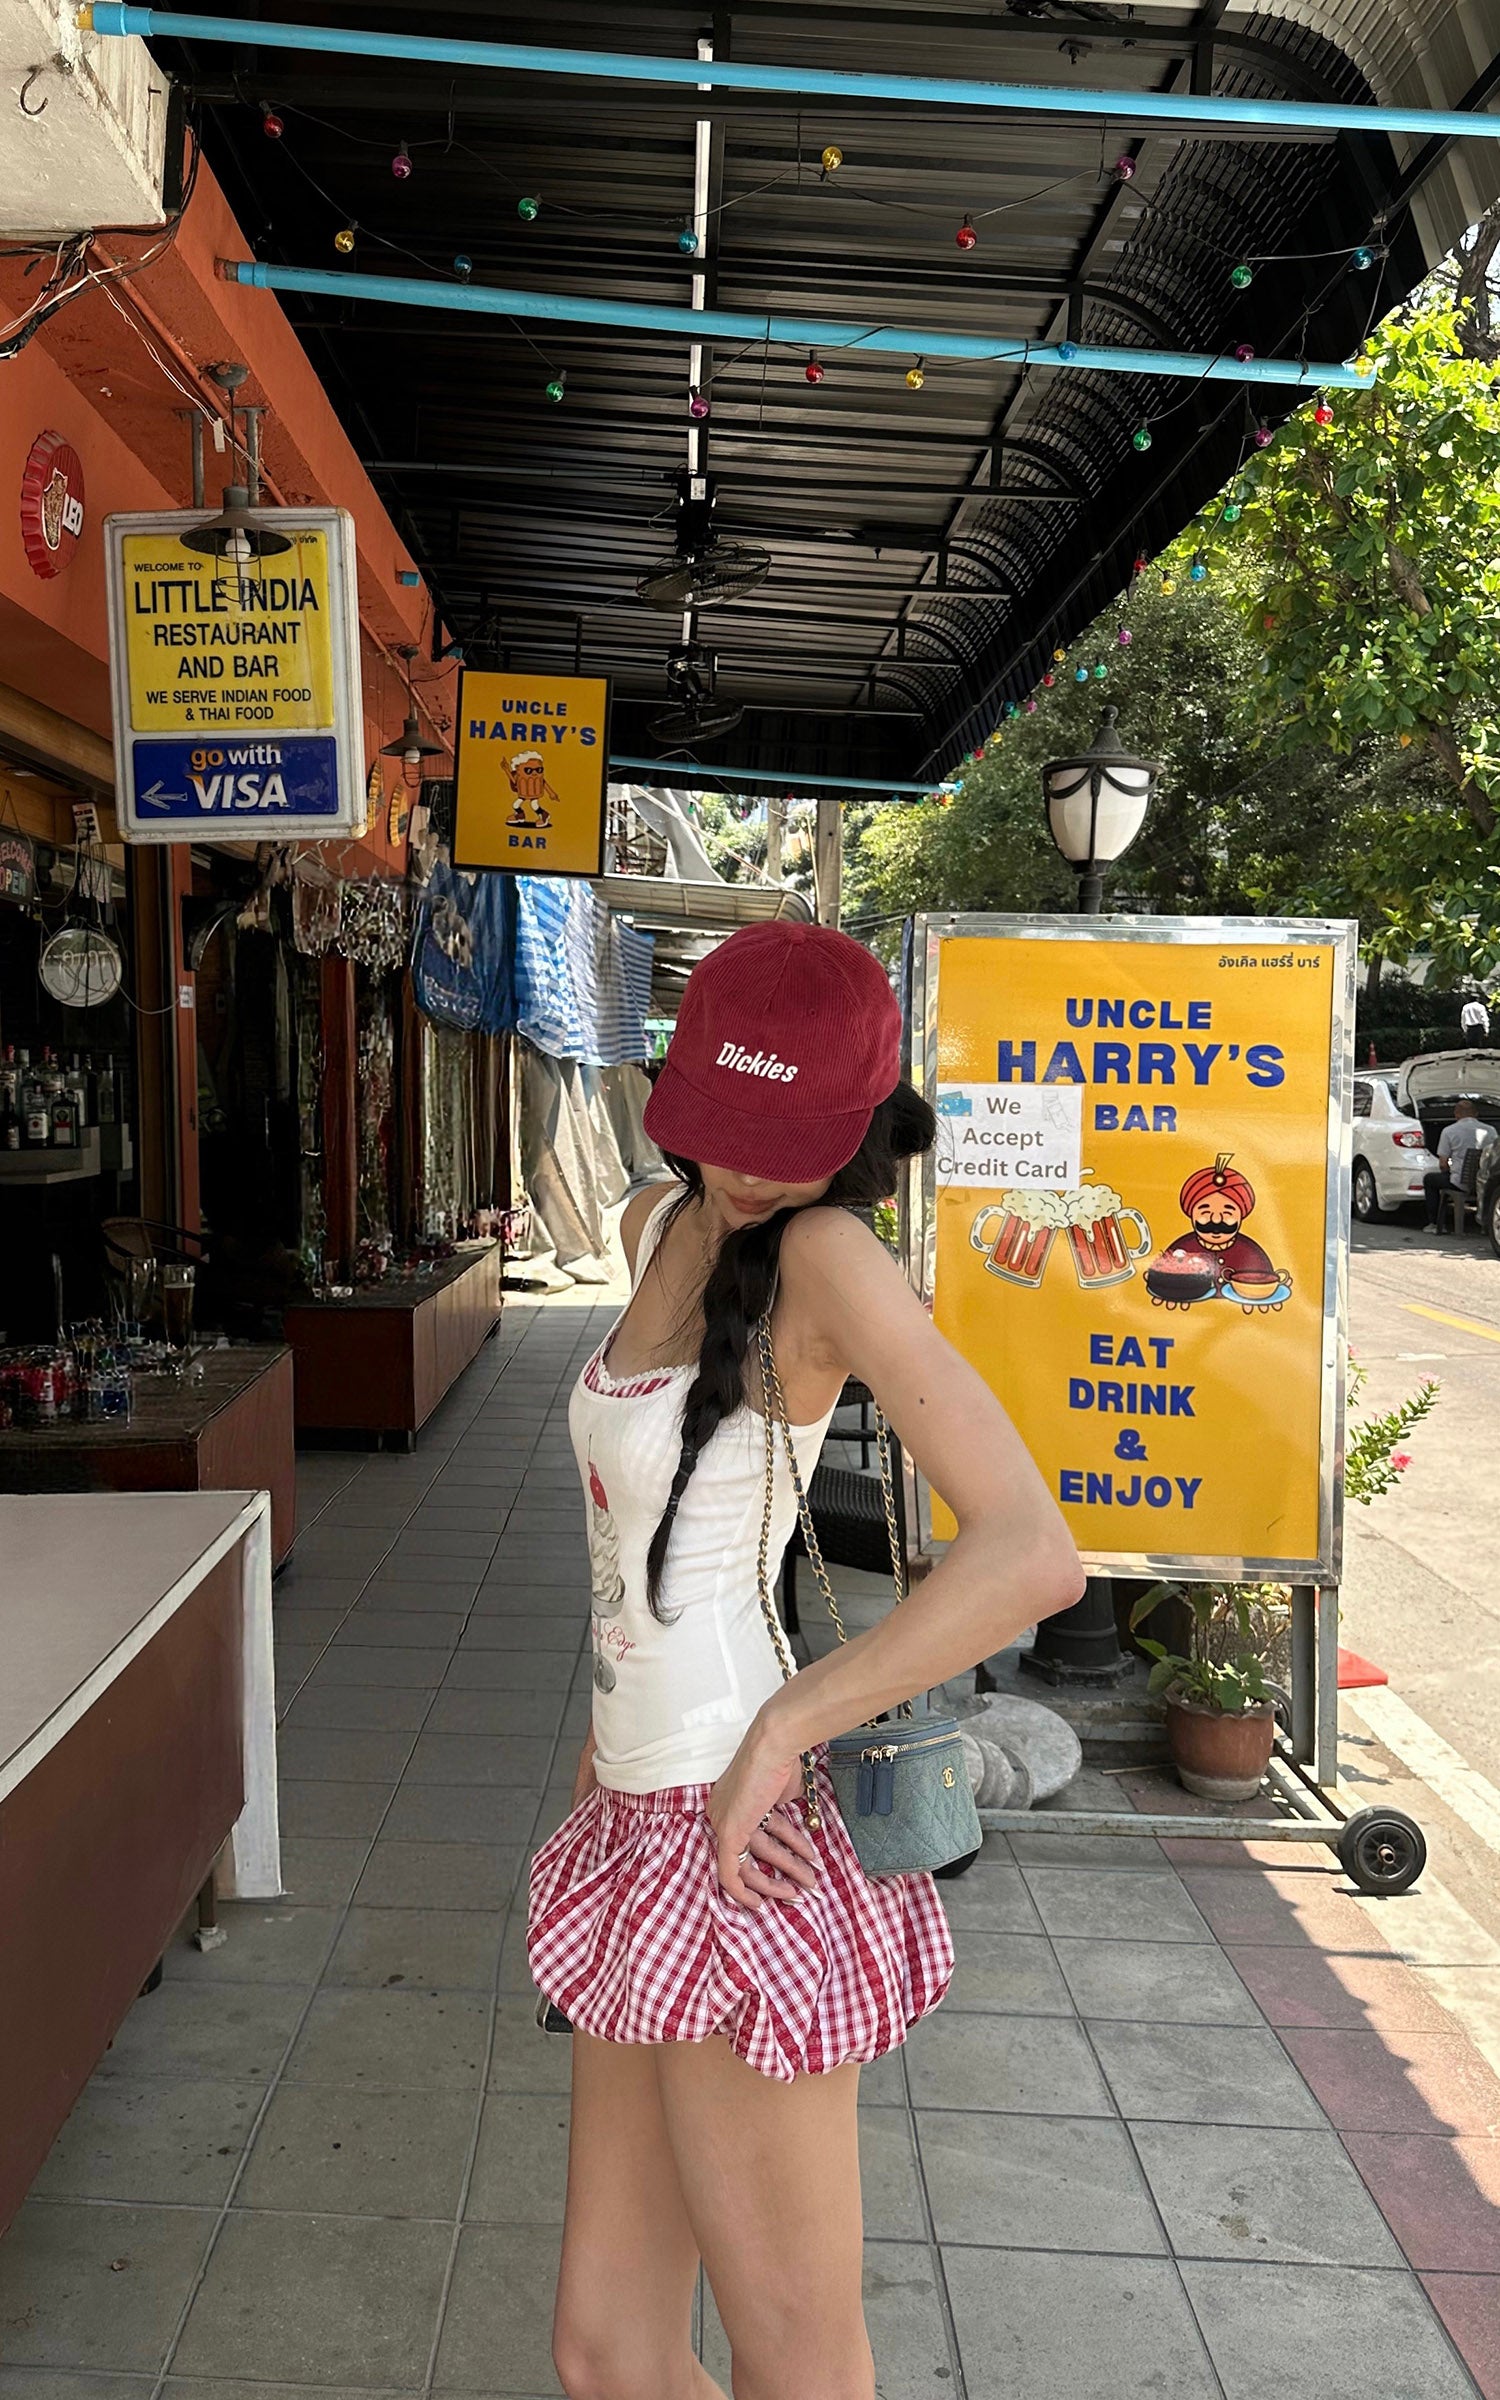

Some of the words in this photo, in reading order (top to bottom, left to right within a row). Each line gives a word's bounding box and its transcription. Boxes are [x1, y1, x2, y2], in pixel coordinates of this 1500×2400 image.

[62, 493, 84, 536] LEO
[134, 563, 185, 572] WELCOME
[188, 562, 202, 571] TO
[135, 579, 228, 613] LITTLE
[240, 578, 319, 612] INDIA
[154, 622, 301, 646] RESTAURANT
[178, 656, 224, 679] AND
[233, 655, 279, 678] BAR
[146, 691, 168, 704] WE
[173, 690, 216, 703] SERVE
[222, 689, 268, 703] INDIAN
[273, 688, 311, 702] FOOD
[502, 699, 567, 716] UNCLE
[185, 708, 195, 720] &
[199, 707, 230, 720] THAI
[235, 707, 274, 720] FOOD
[469, 720, 597, 746] HARRY'S
[191, 749, 224, 771] go
[227, 744, 281, 765] with
[185, 773, 289, 809] VISA
[508, 835, 547, 849] BAR
[1218, 955, 1257, 968] อังเคิล
[1297, 955, 1320, 968] บาร์
[1066, 998, 1212, 1029] UNCLE
[715, 1041, 799, 1083] Dickies
[997, 1040, 1285, 1088] HARRY'S
[986, 1097, 1022, 1115] We
[1095, 1104, 1177, 1132] BAR
[962, 1127, 1044, 1151] Accept
[937, 1157, 1008, 1177] Credit
[1015, 1160, 1068, 1179] Card
[1090, 1333, 1175, 1369] EAT
[1069, 1377, 1196, 1417] DRINK
[1114, 1428, 1149, 1461] &
[1060, 1469, 1203, 1509] ENJOY
